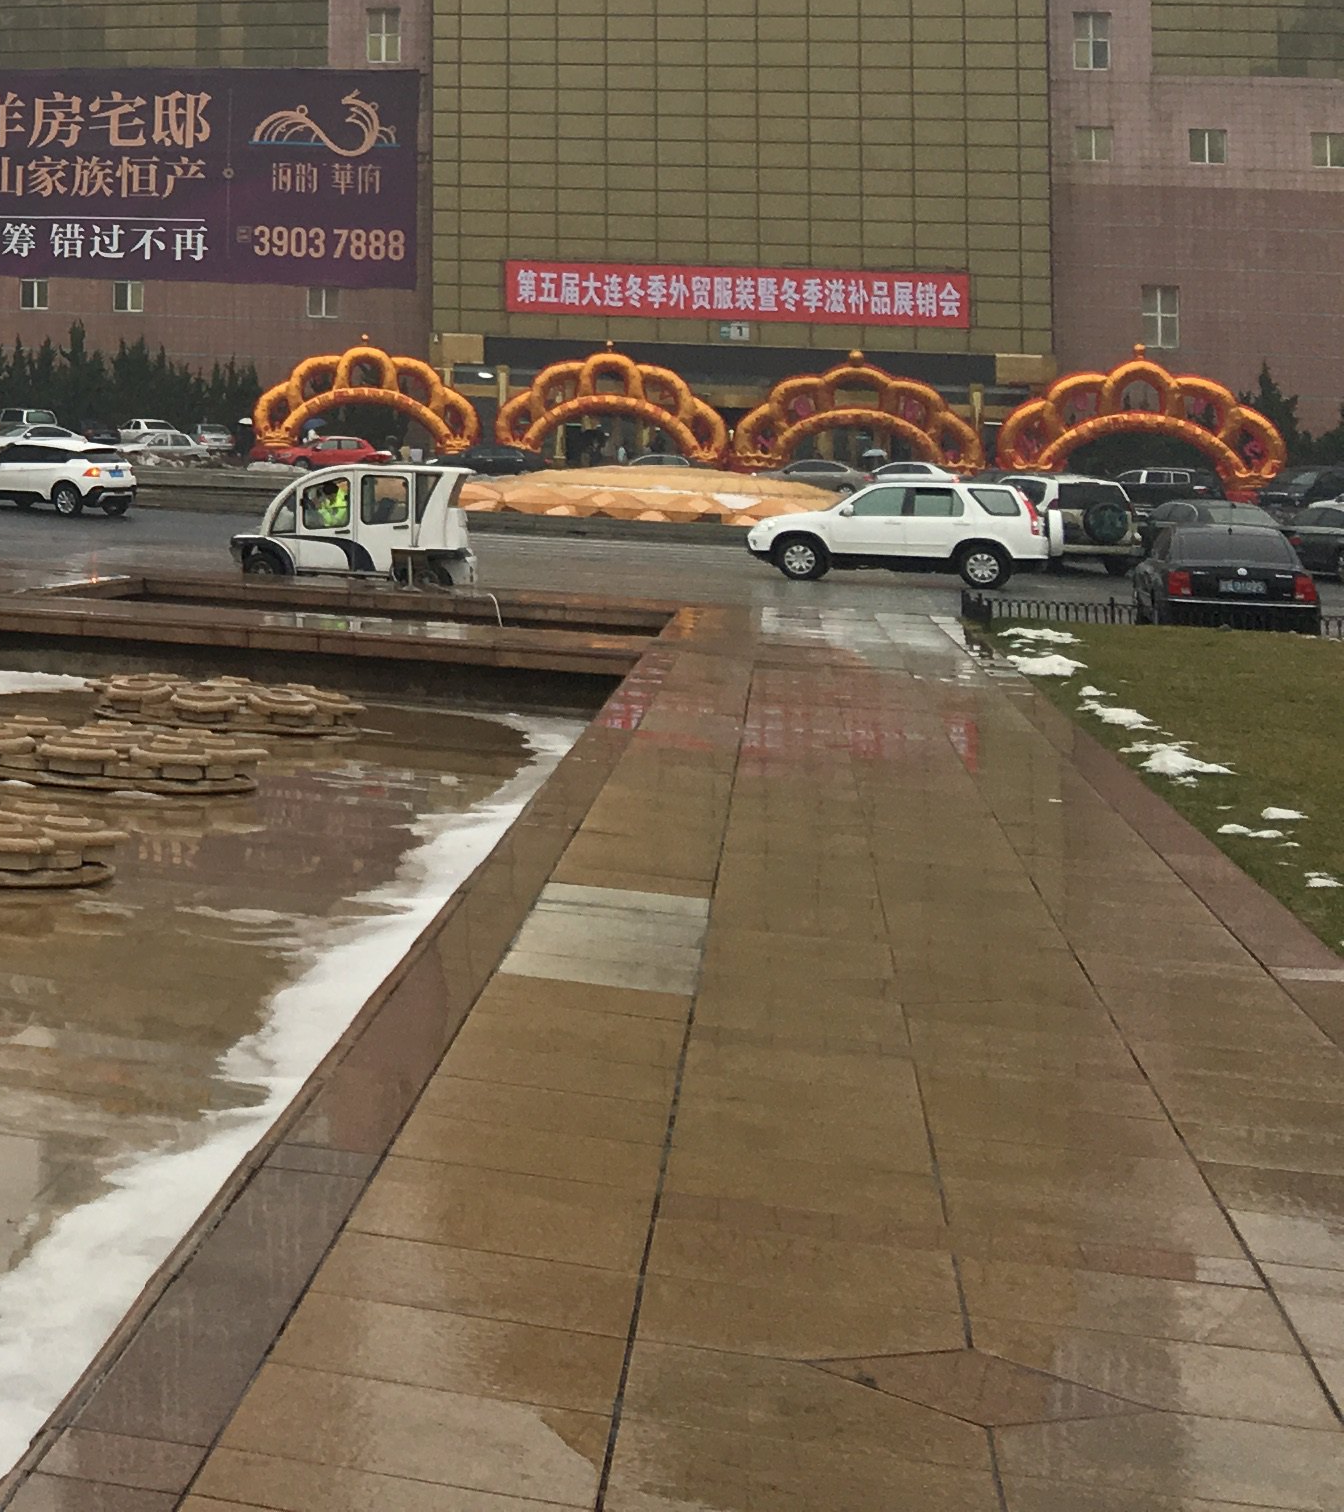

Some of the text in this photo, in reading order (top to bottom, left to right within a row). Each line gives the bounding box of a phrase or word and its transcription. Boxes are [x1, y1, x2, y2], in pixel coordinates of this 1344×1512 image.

[49, 224, 208, 261] 错过不再
[253, 225, 405, 261] 3903 7888
[516, 269, 961, 318] 第五届大连冬季外贸服装暨冬季滋补品展销会
